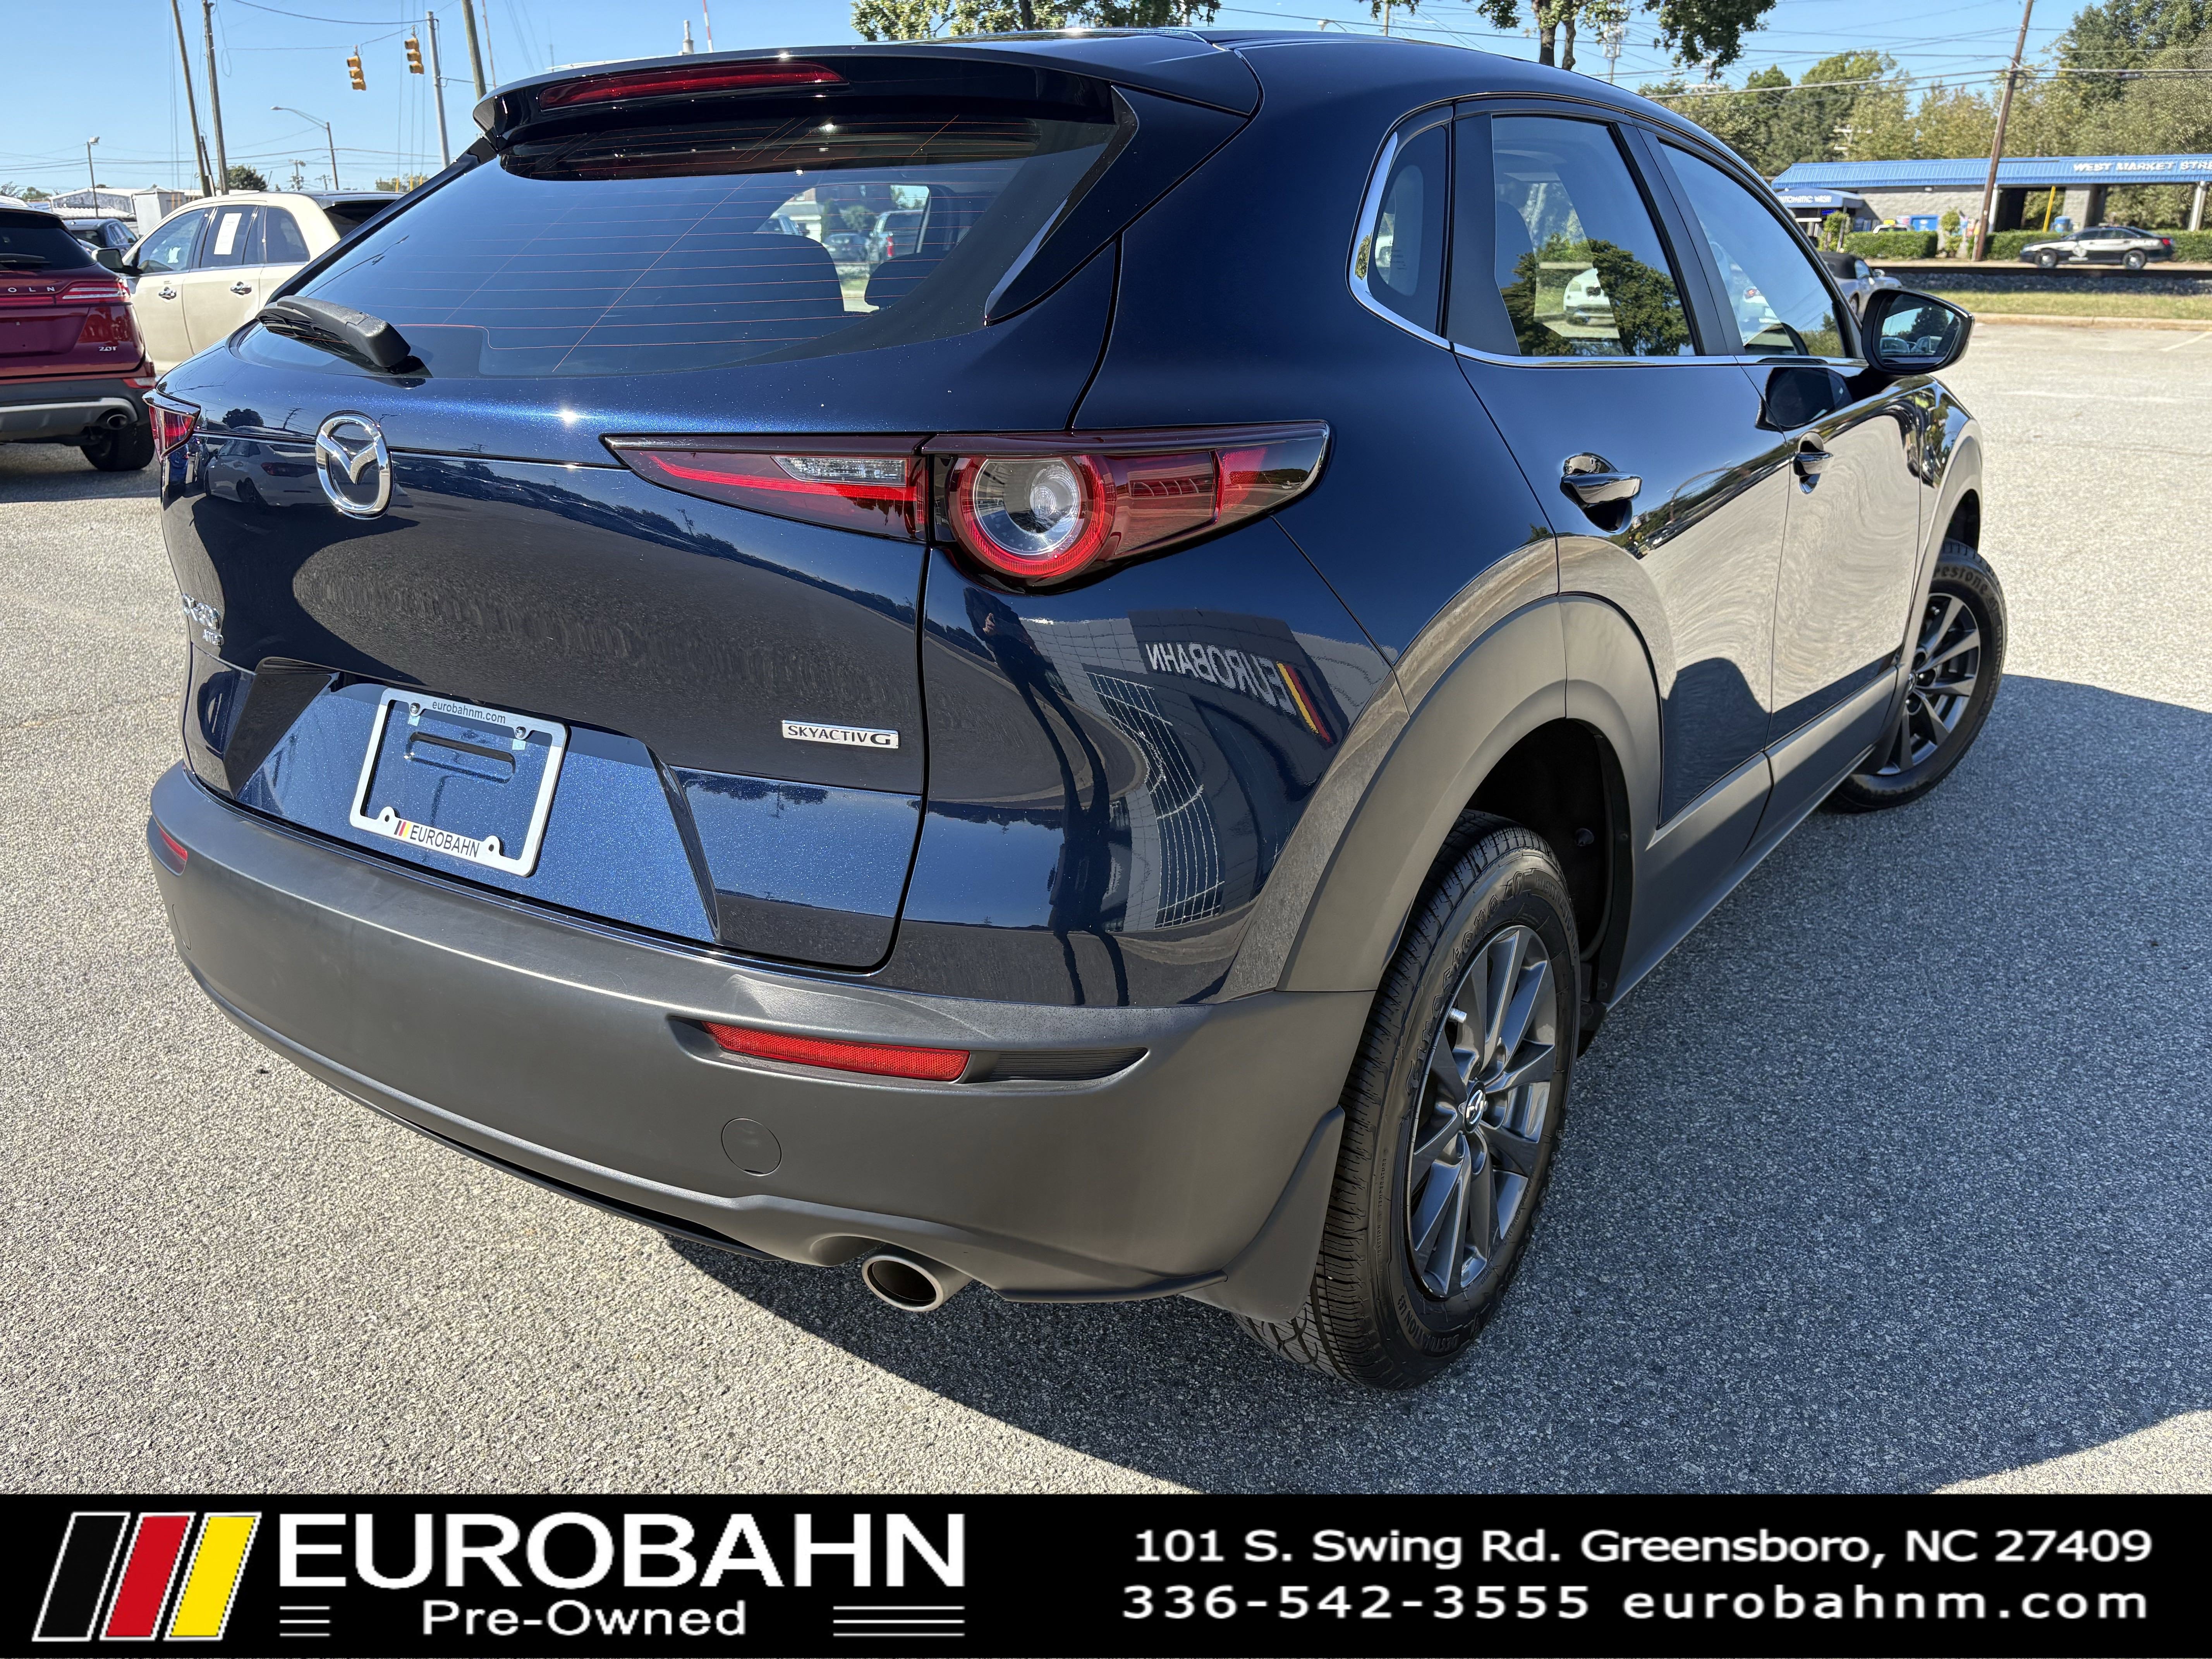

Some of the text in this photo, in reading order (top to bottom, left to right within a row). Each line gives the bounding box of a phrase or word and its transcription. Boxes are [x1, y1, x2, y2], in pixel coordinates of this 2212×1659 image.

[2073, 163, 2112, 172] WEST
[2116, 162, 2176, 172] MARKET
[432, 700, 506, 724] eurobahnm.com
[410, 824, 480, 858] EUROBAHN
